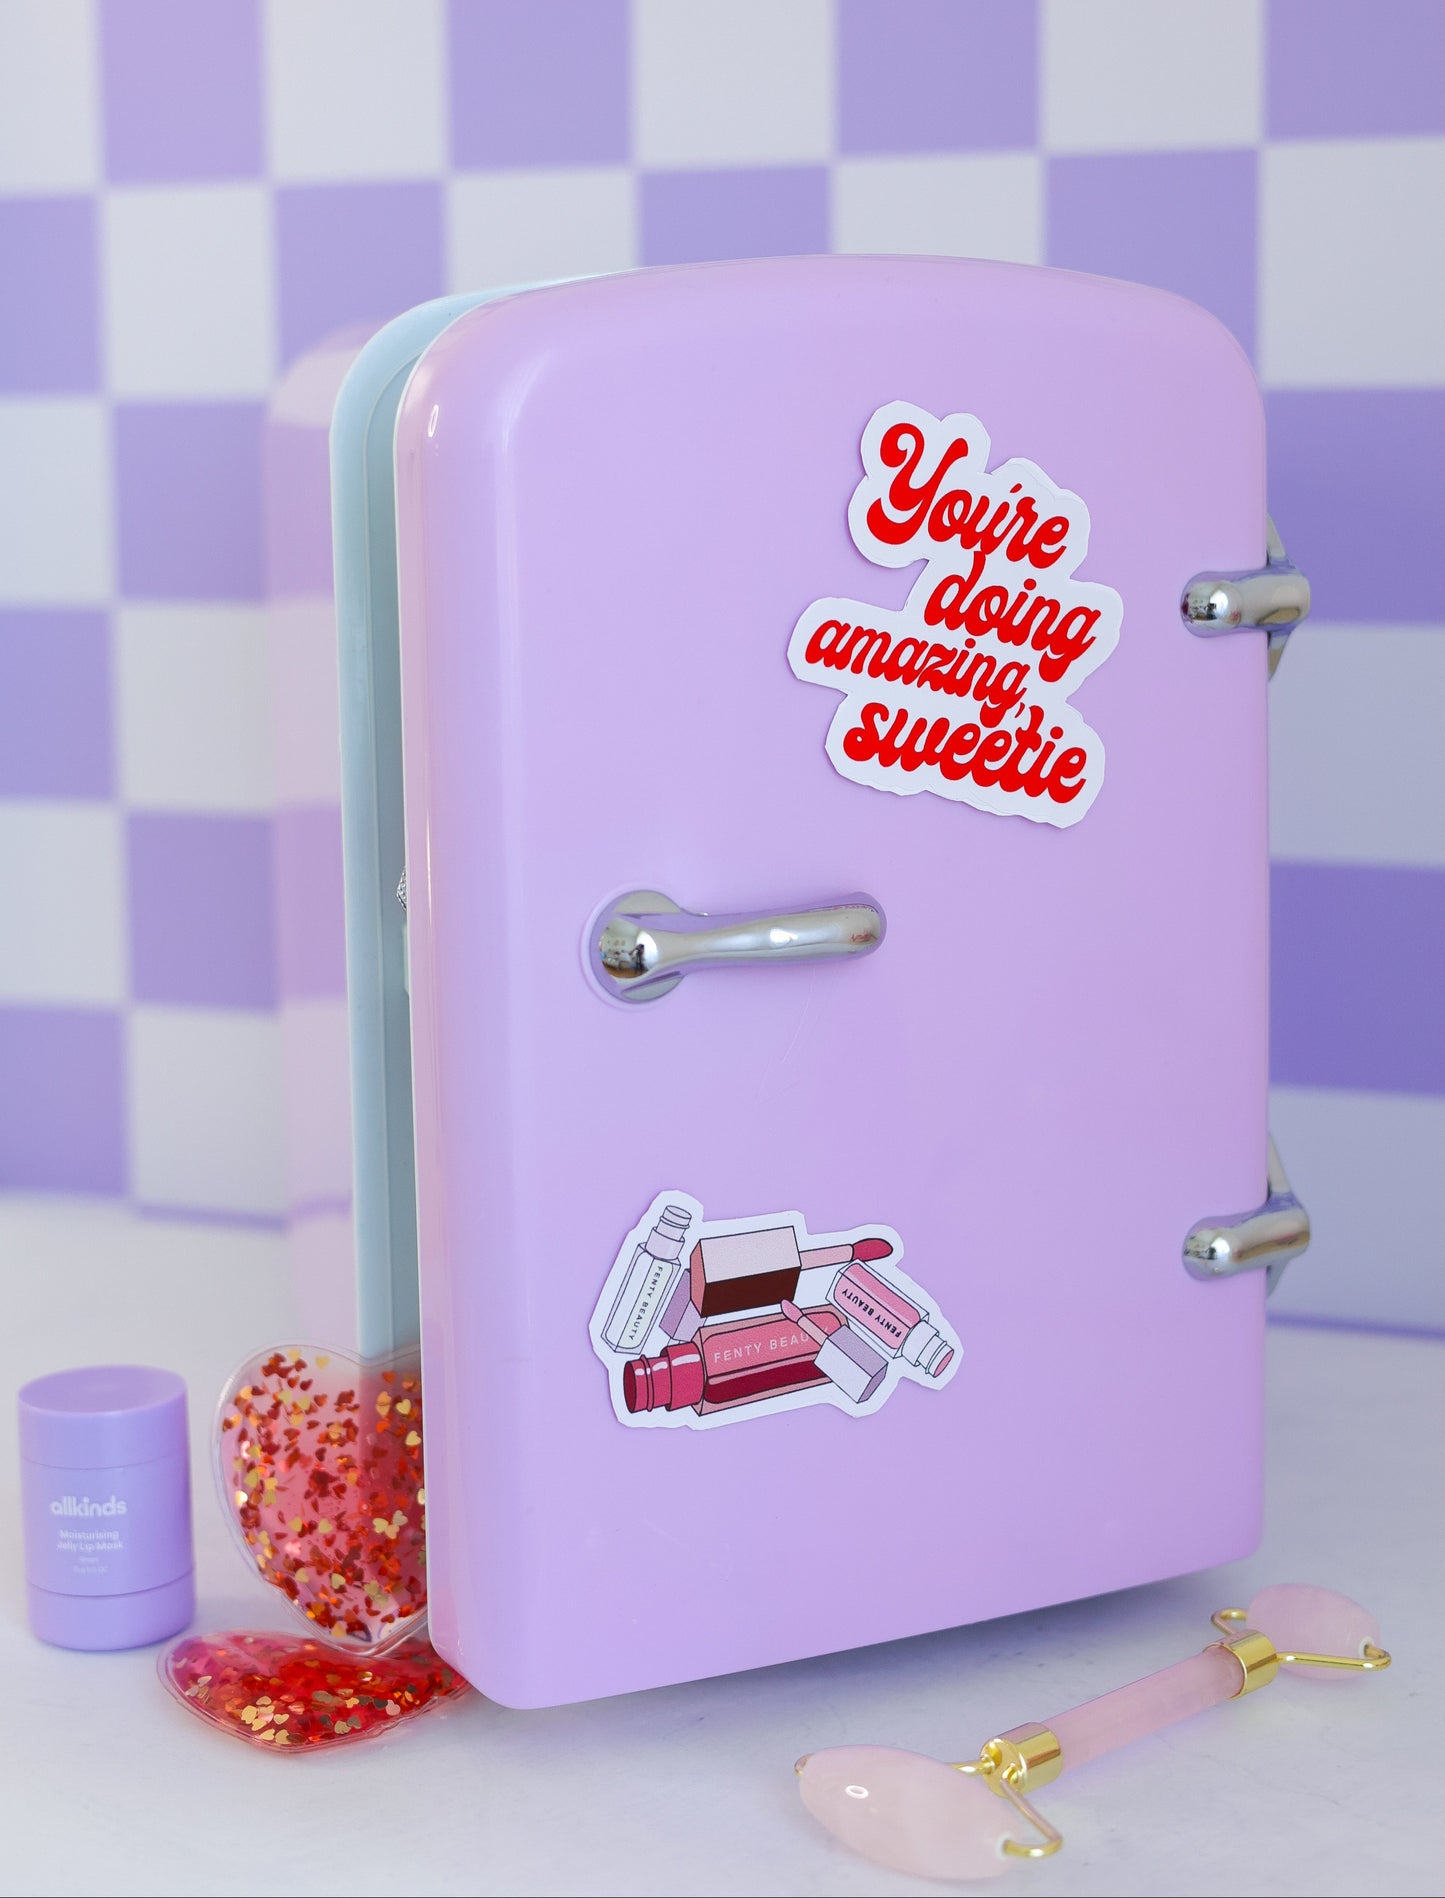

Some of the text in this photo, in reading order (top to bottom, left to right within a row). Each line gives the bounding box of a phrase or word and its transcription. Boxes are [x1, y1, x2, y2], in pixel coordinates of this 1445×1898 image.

[867, 423, 1070, 569] You're
[923, 550, 1102, 683] doing
[804, 620, 1031, 729] amazing,
[842, 702, 1087, 804] sweetie
[628, 1265, 664, 1341] FENTY BEAUTY
[841, 1288, 902, 1338] FENTY BEAUTY
[713, 1342, 762, 1364] FENTY
[50, 1495, 128, 1517] allkinds
